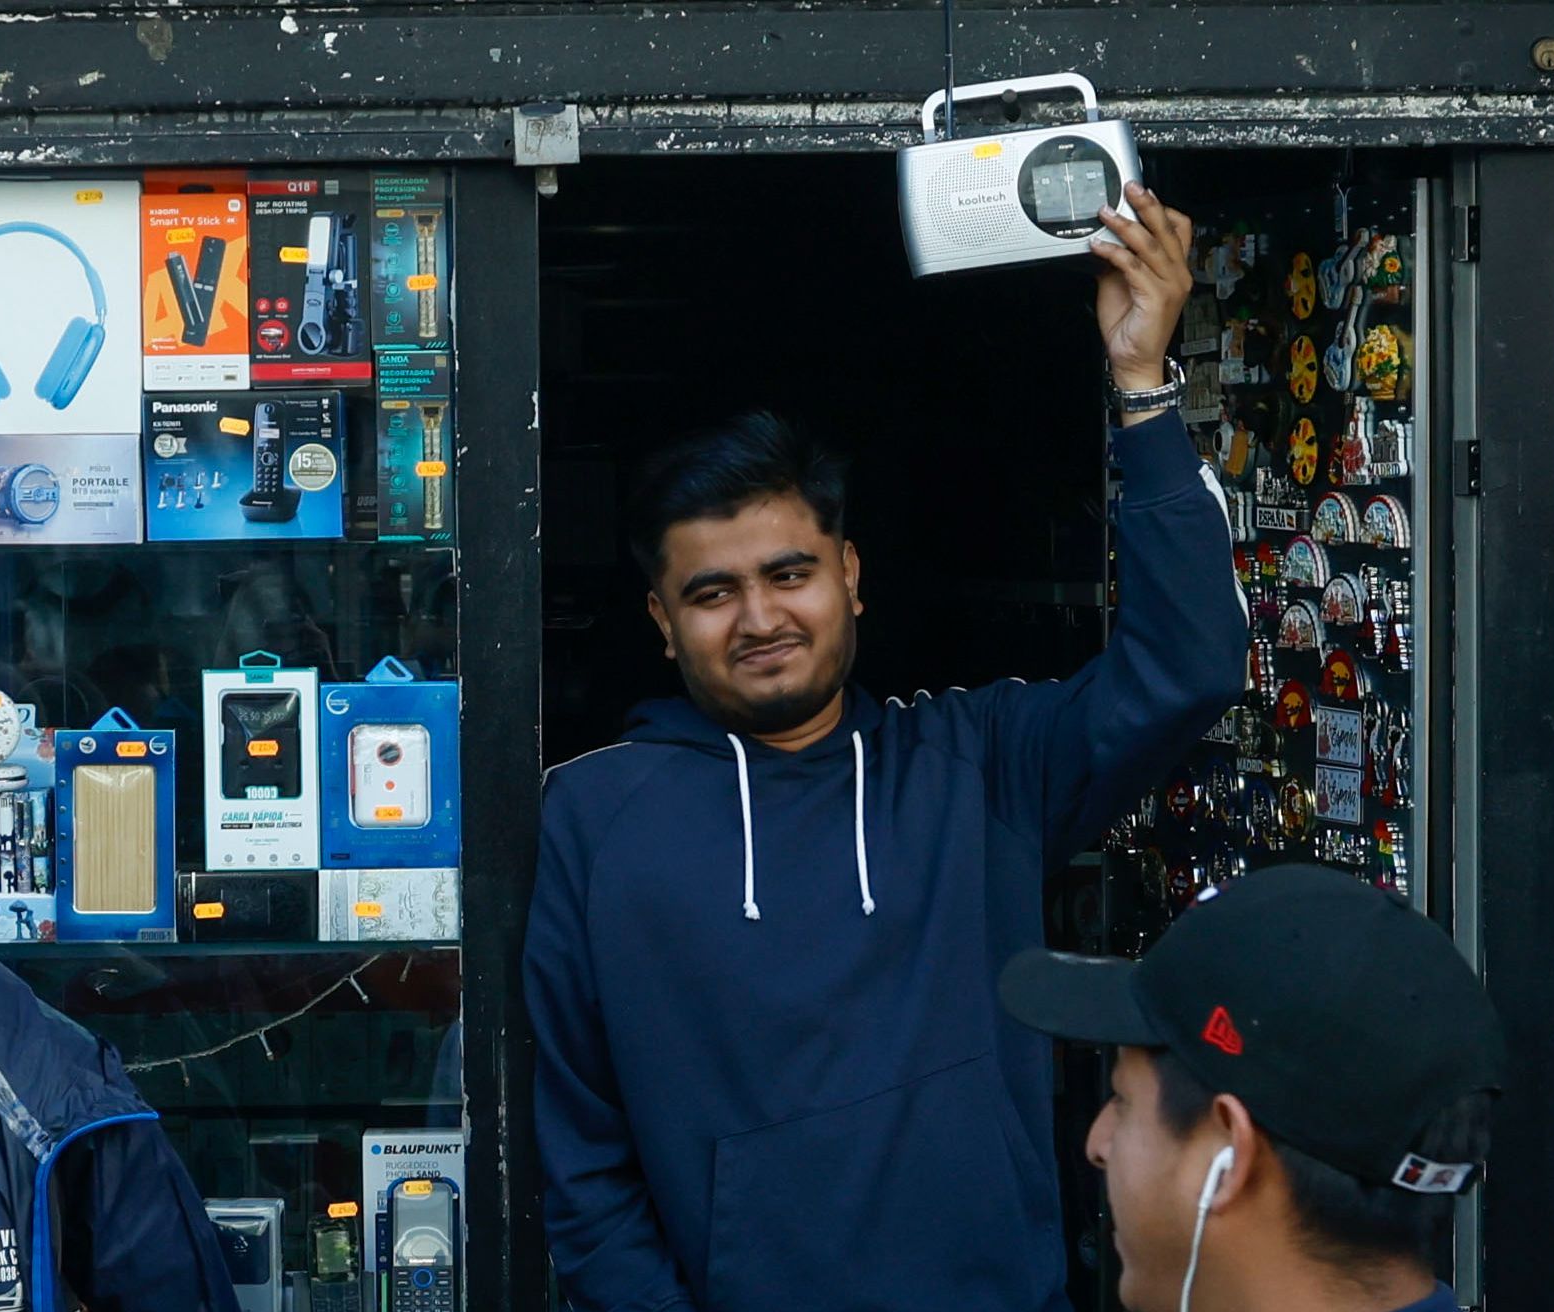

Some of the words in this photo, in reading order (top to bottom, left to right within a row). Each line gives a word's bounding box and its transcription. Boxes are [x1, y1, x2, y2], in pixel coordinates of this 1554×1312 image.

[287, 182, 311, 192] Q18
[272, 200, 307, 208] ROTATING
[958, 191, 1006, 207] kooltech
[149, 217, 177, 226] Smart
[181, 217, 194, 226] TV
[197, 216, 221, 226] Stick
[379, 355, 410, 364] SANDA
[379, 369, 435, 377] RECORTADORA
[379, 377, 431, 385] PROFESIONAL
[152, 400, 218, 413] Panasonic
[295, 452, 312, 469] 15
[71, 477, 129, 487] PORTABLE
[1257, 508, 1286, 528] ESPAÑA
[221, 812, 250, 822] CARGA
[252, 810, 283, 822] RÁPIDA
[383, 1144, 462, 1155] BLAUPUNKT
[385, 1161, 439, 1169] RUGGEDIZED
[385, 1170, 415, 1178] PHONE
[416, 1170, 441, 1178] SAND
